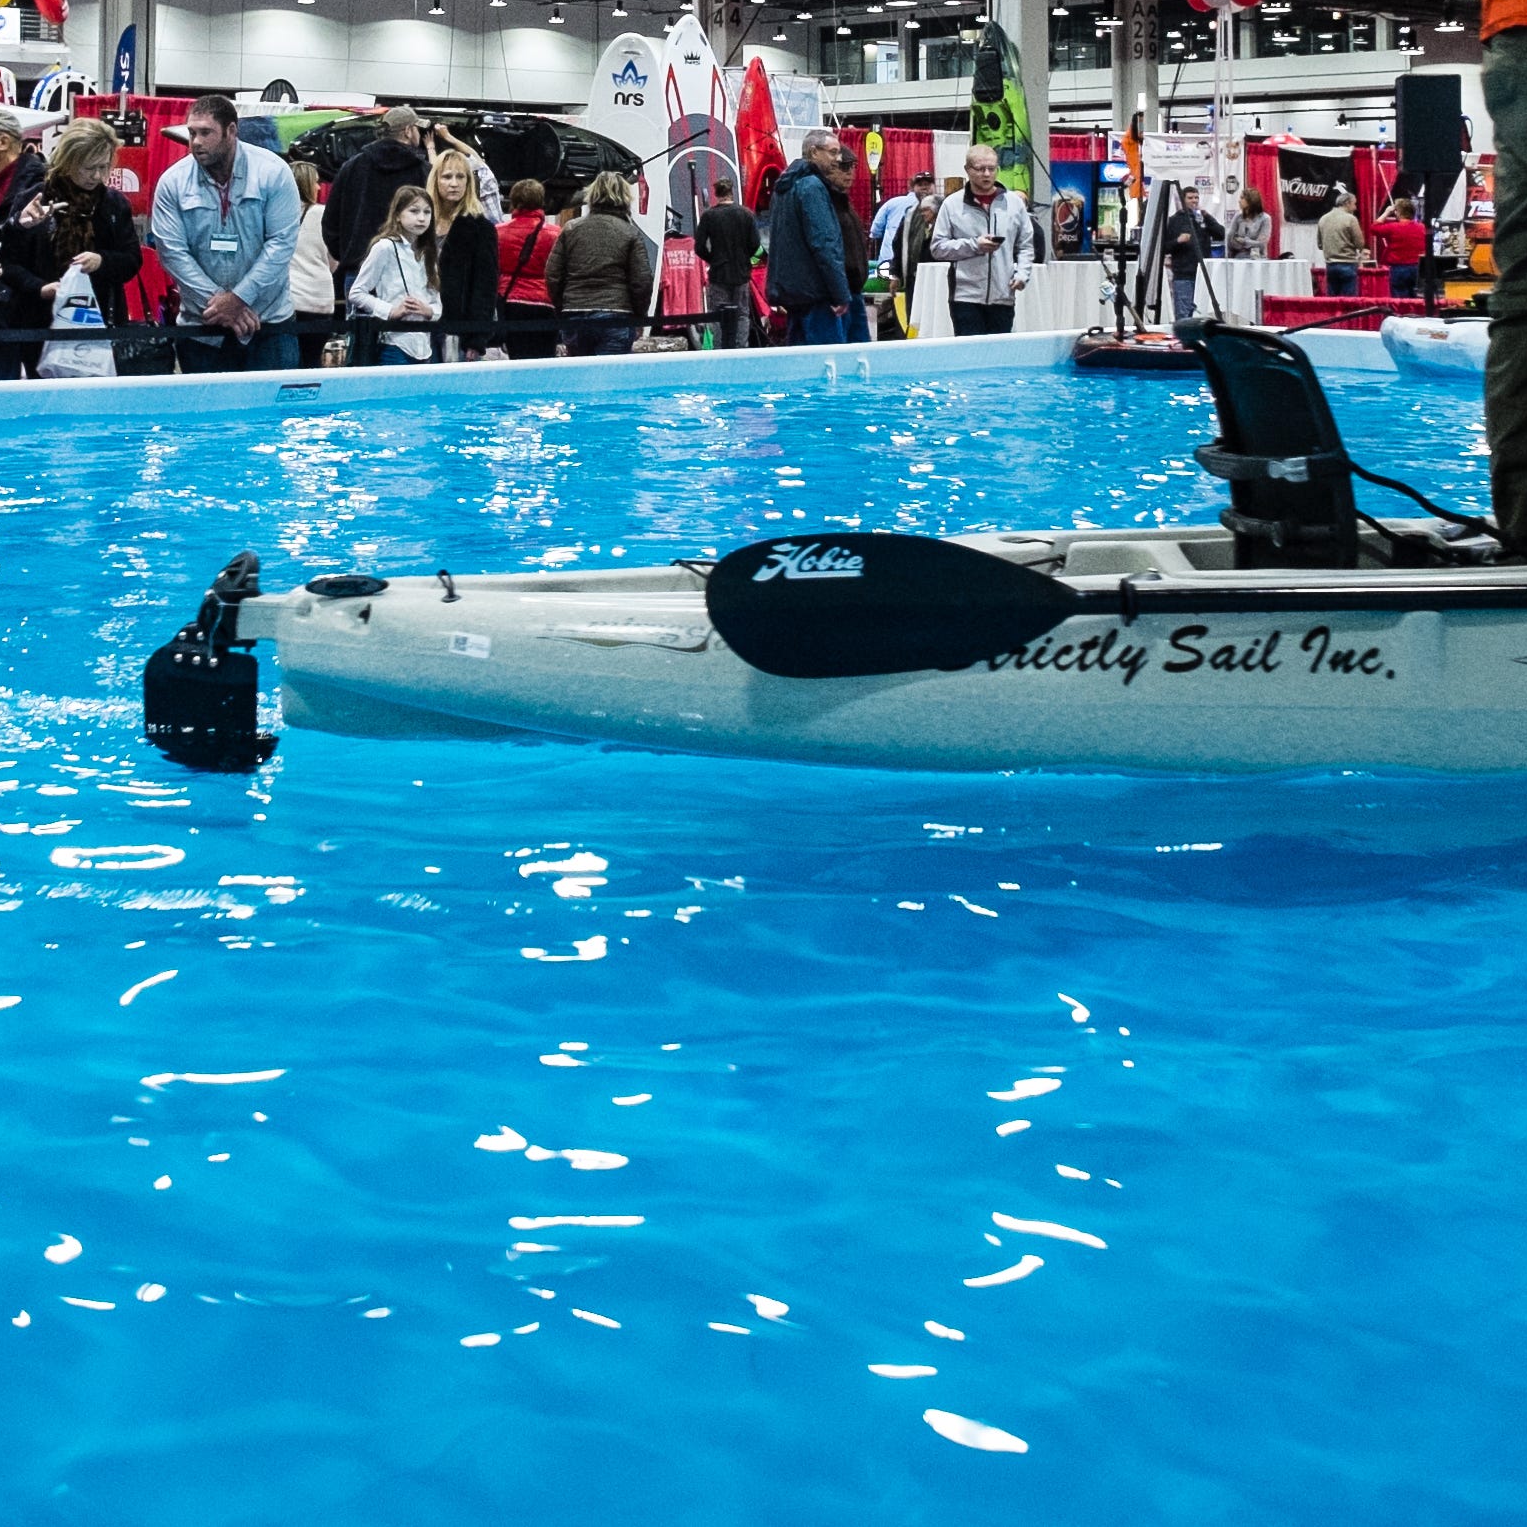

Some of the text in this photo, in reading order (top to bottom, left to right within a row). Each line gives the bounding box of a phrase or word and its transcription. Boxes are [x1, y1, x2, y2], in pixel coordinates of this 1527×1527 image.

[1131, 0, 1145, 60] A29
[614, 91, 645, 106] nrs
[1057, 233, 1079, 243] pepsi
[751, 543, 865, 581] Hobie
[1161, 624, 1282, 674] Sail
[1300, 625, 1397, 680] Inc.
